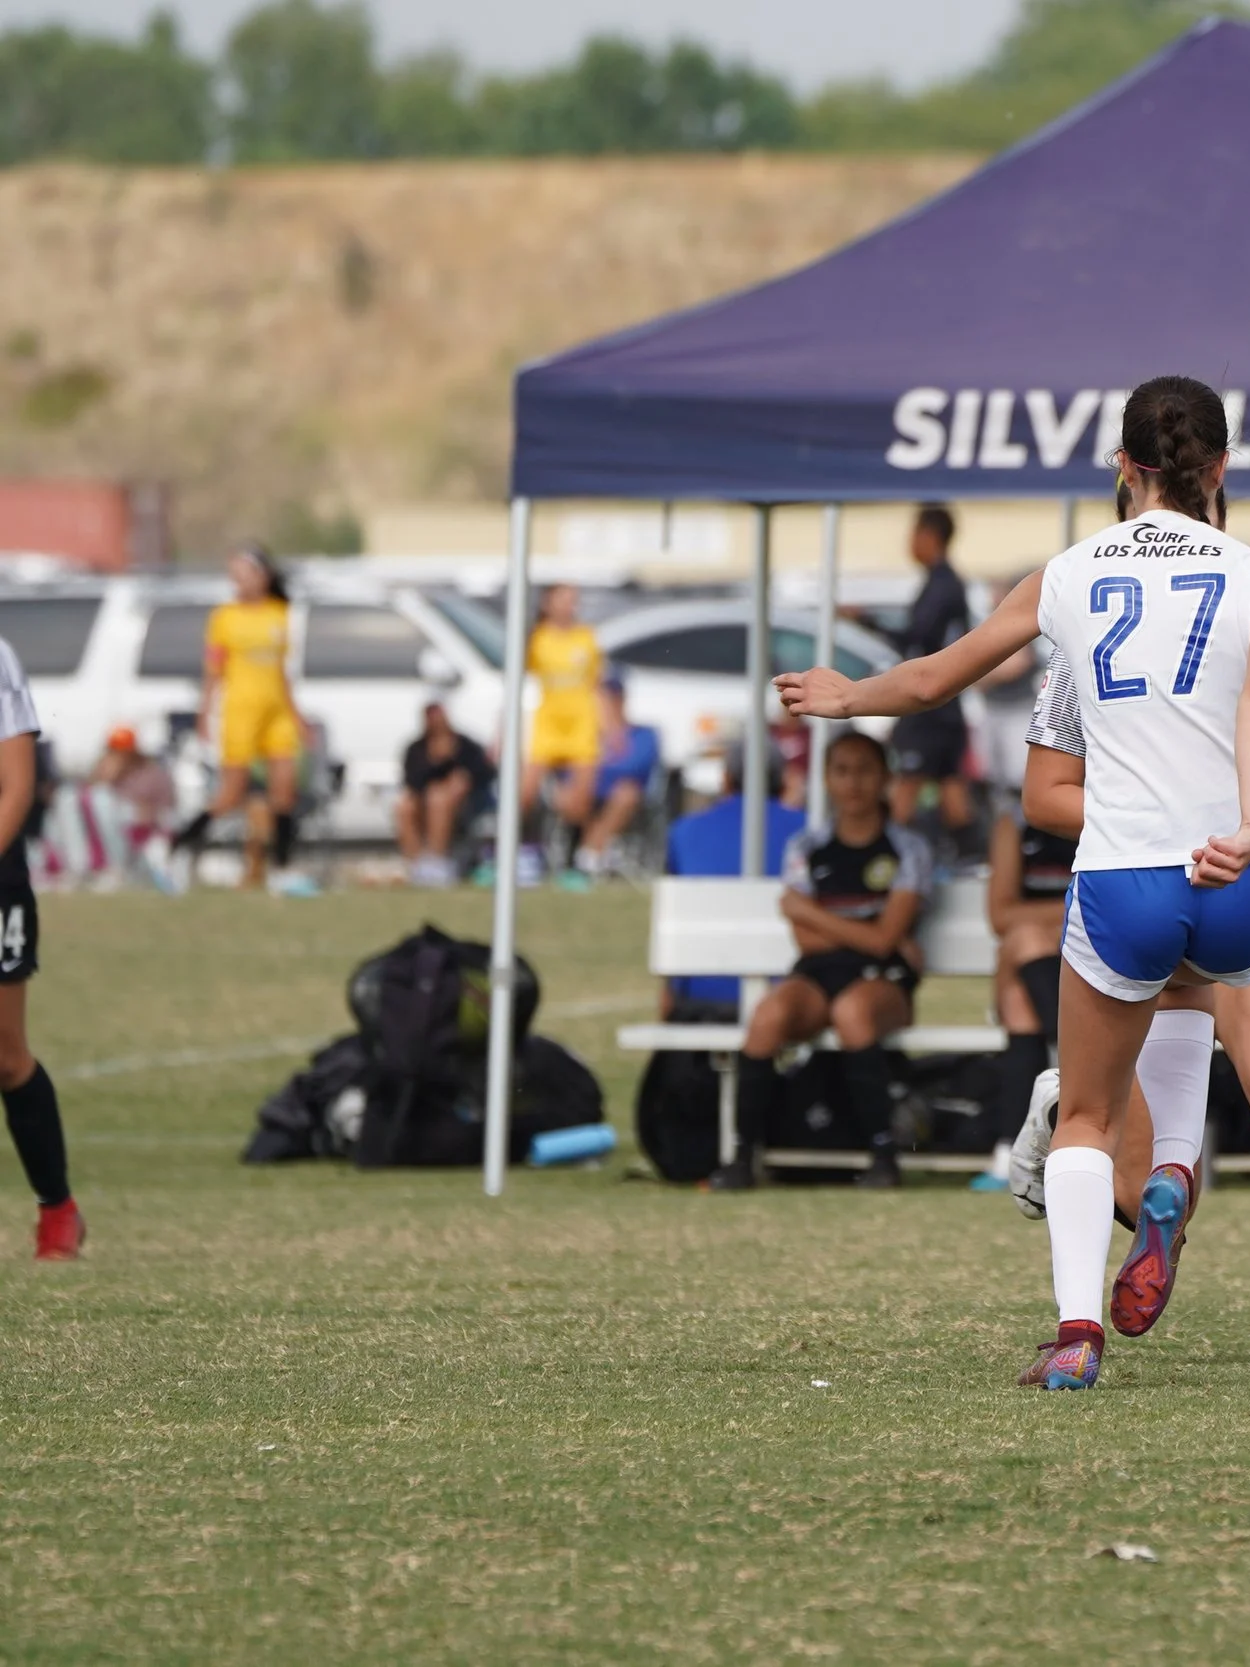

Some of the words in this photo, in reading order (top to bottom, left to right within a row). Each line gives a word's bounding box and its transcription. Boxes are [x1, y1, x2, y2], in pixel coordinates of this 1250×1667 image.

[1093, 544, 1131, 558] LOS
[1133, 544, 1223, 558] ANGELES
[1144, 531, 1190, 544] SURF
[1090, 573, 1225, 700] 27
[0, 905, 26, 958] 4
